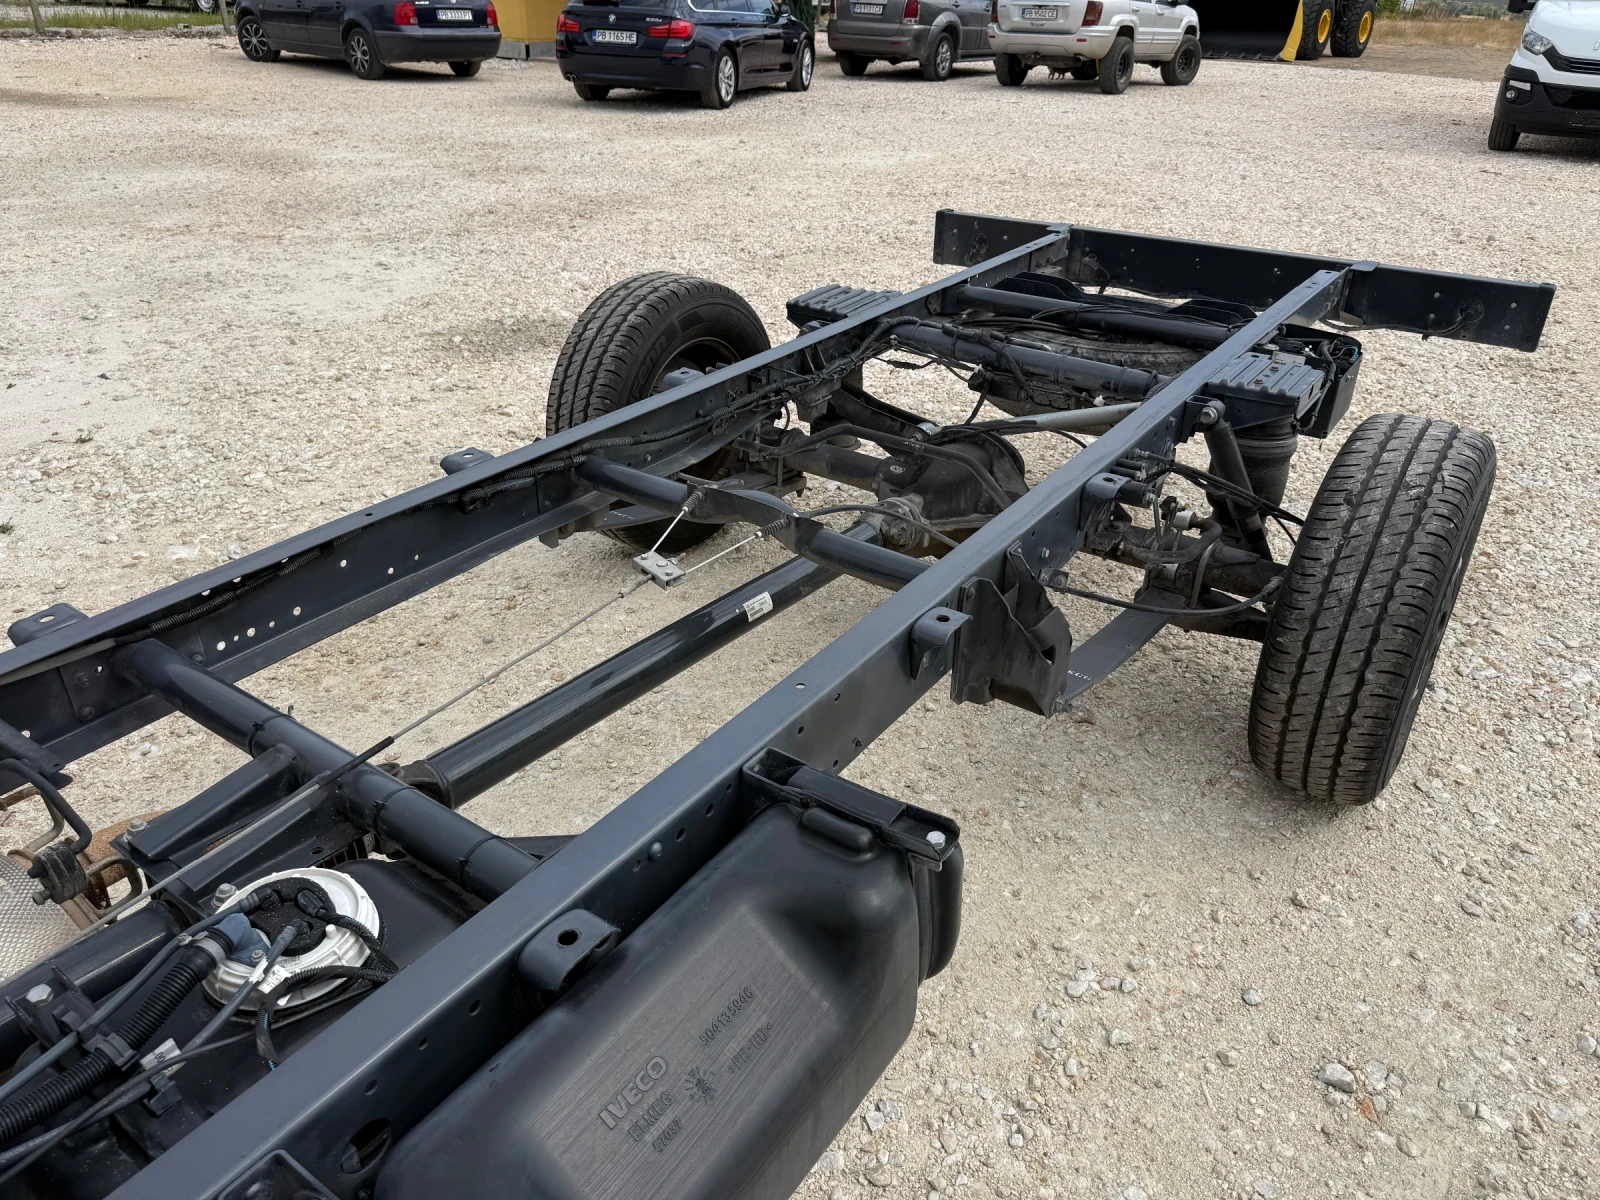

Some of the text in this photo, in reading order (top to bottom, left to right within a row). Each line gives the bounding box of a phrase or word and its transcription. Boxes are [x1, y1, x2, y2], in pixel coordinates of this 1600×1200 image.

[449, 10, 463, 18] 3333
[597, 31, 635, 42] PB 1165 HE
[699, 985, 755, 1046] 504135946
[598, 1056, 668, 1130] IVECO
[627, 1091, 674, 1142] ELMEG
[651, 1117, 683, 1153] 57037
